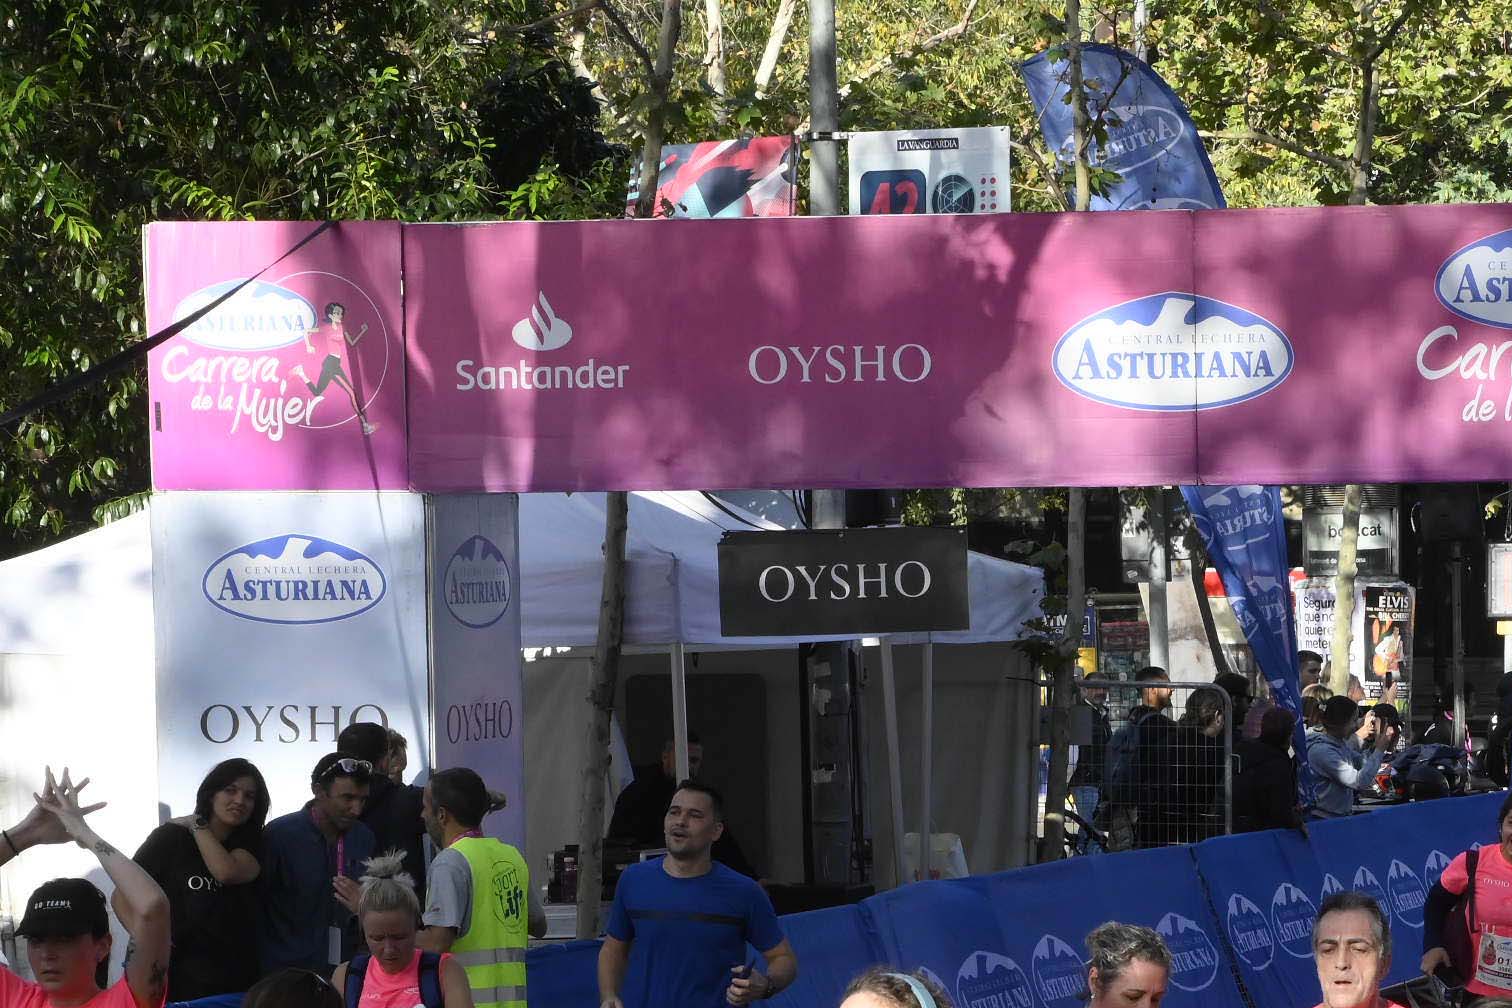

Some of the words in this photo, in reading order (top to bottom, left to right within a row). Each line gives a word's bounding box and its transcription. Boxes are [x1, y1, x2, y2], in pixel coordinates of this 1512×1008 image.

[1107, 334, 1183, 345] CENTRAL
[1190, 333, 1267, 345] LECHERA
[160, 344, 281, 384] Carrera
[456, 358, 631, 392] Santander
[748, 342, 933, 385] OYSHO
[1072, 337, 1276, 381] ASTURIANA
[191, 383, 212, 411] de
[217, 381, 234, 411] la
[231, 380, 325, 442] Mujer
[1462, 384, 1496, 422] de
[1328, 523, 1382, 538] b.cat
[217, 567, 373, 602] ASTURIANA
[244, 566, 302, 576] CENTRAL
[308, 565, 368, 575] LECHERA
[758, 560, 932, 603] OYSHO
[449, 575, 507, 606] ASTURIANA
[1378, 596, 1409, 609] ELVIS
[446, 699, 514, 746] OYSHO
